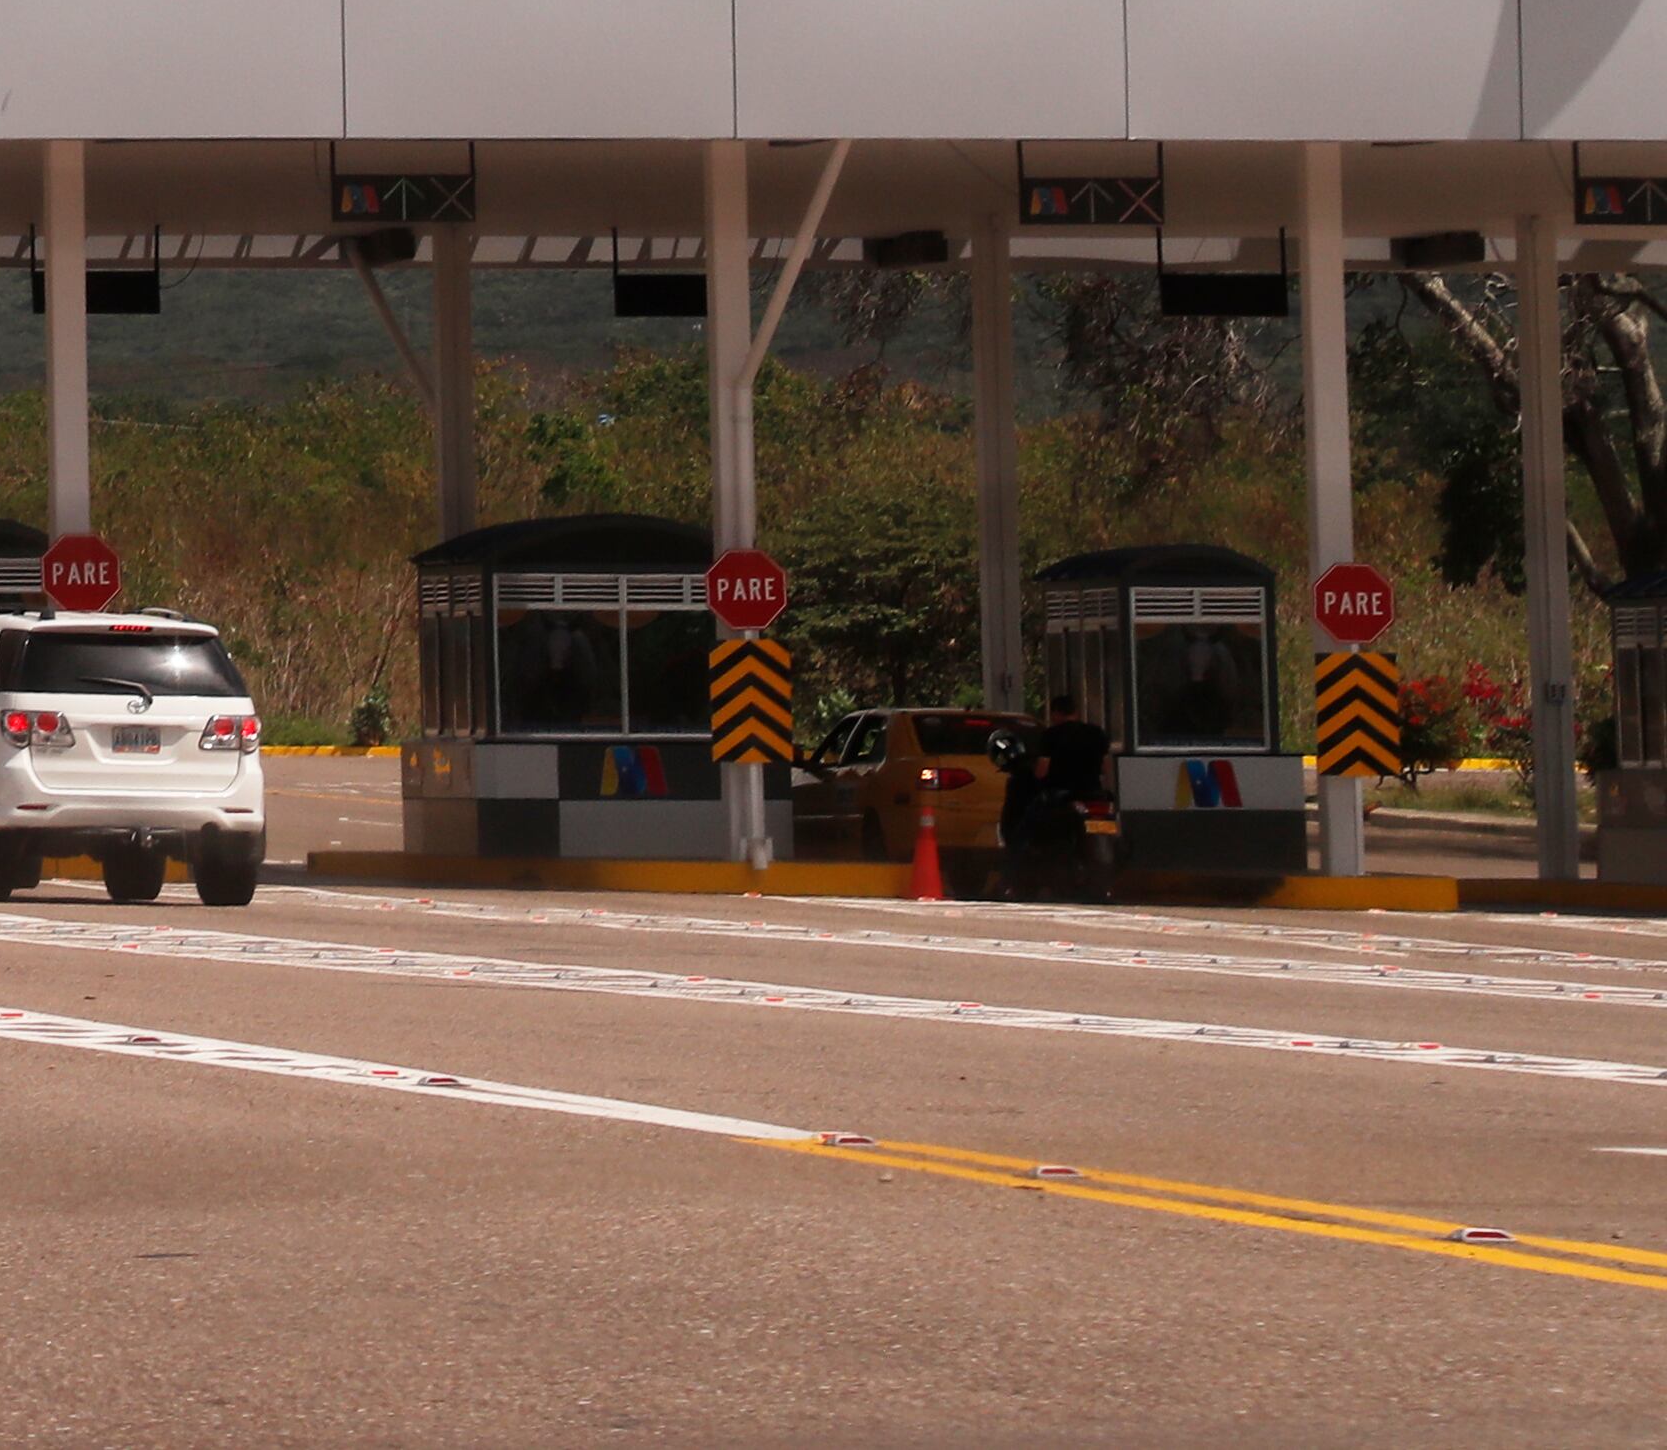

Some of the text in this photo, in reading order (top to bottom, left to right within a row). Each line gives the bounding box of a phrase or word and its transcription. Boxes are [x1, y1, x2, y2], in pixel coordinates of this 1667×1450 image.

[52, 560, 111, 586] PARE
[717, 577, 777, 602] PARE
[1324, 590, 1384, 616] PARE
